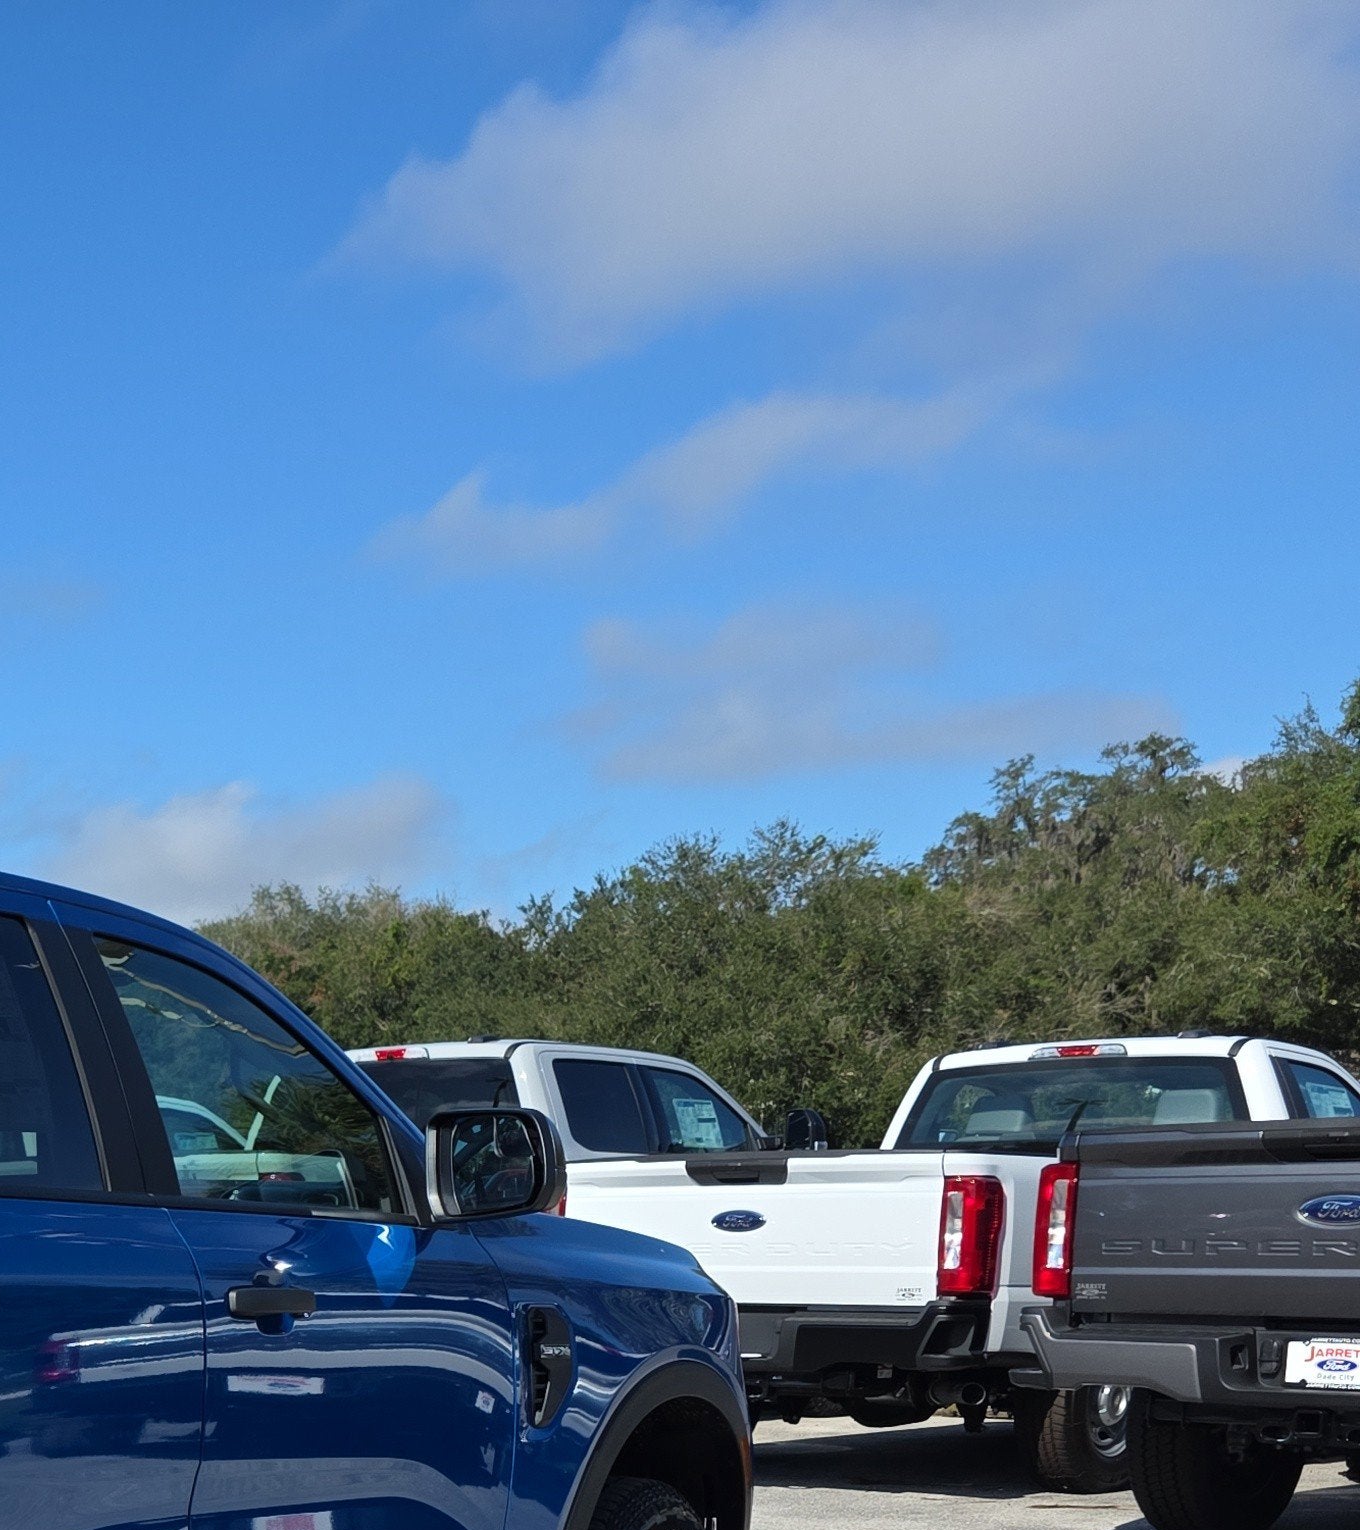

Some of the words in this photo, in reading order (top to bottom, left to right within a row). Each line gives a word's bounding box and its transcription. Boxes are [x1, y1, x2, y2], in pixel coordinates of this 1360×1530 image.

[1101, 1239, 1359, 1257] SUPER
[1304, 1346, 1360, 1362] JARRET
[1322, 1360, 1352, 1371] Ford
